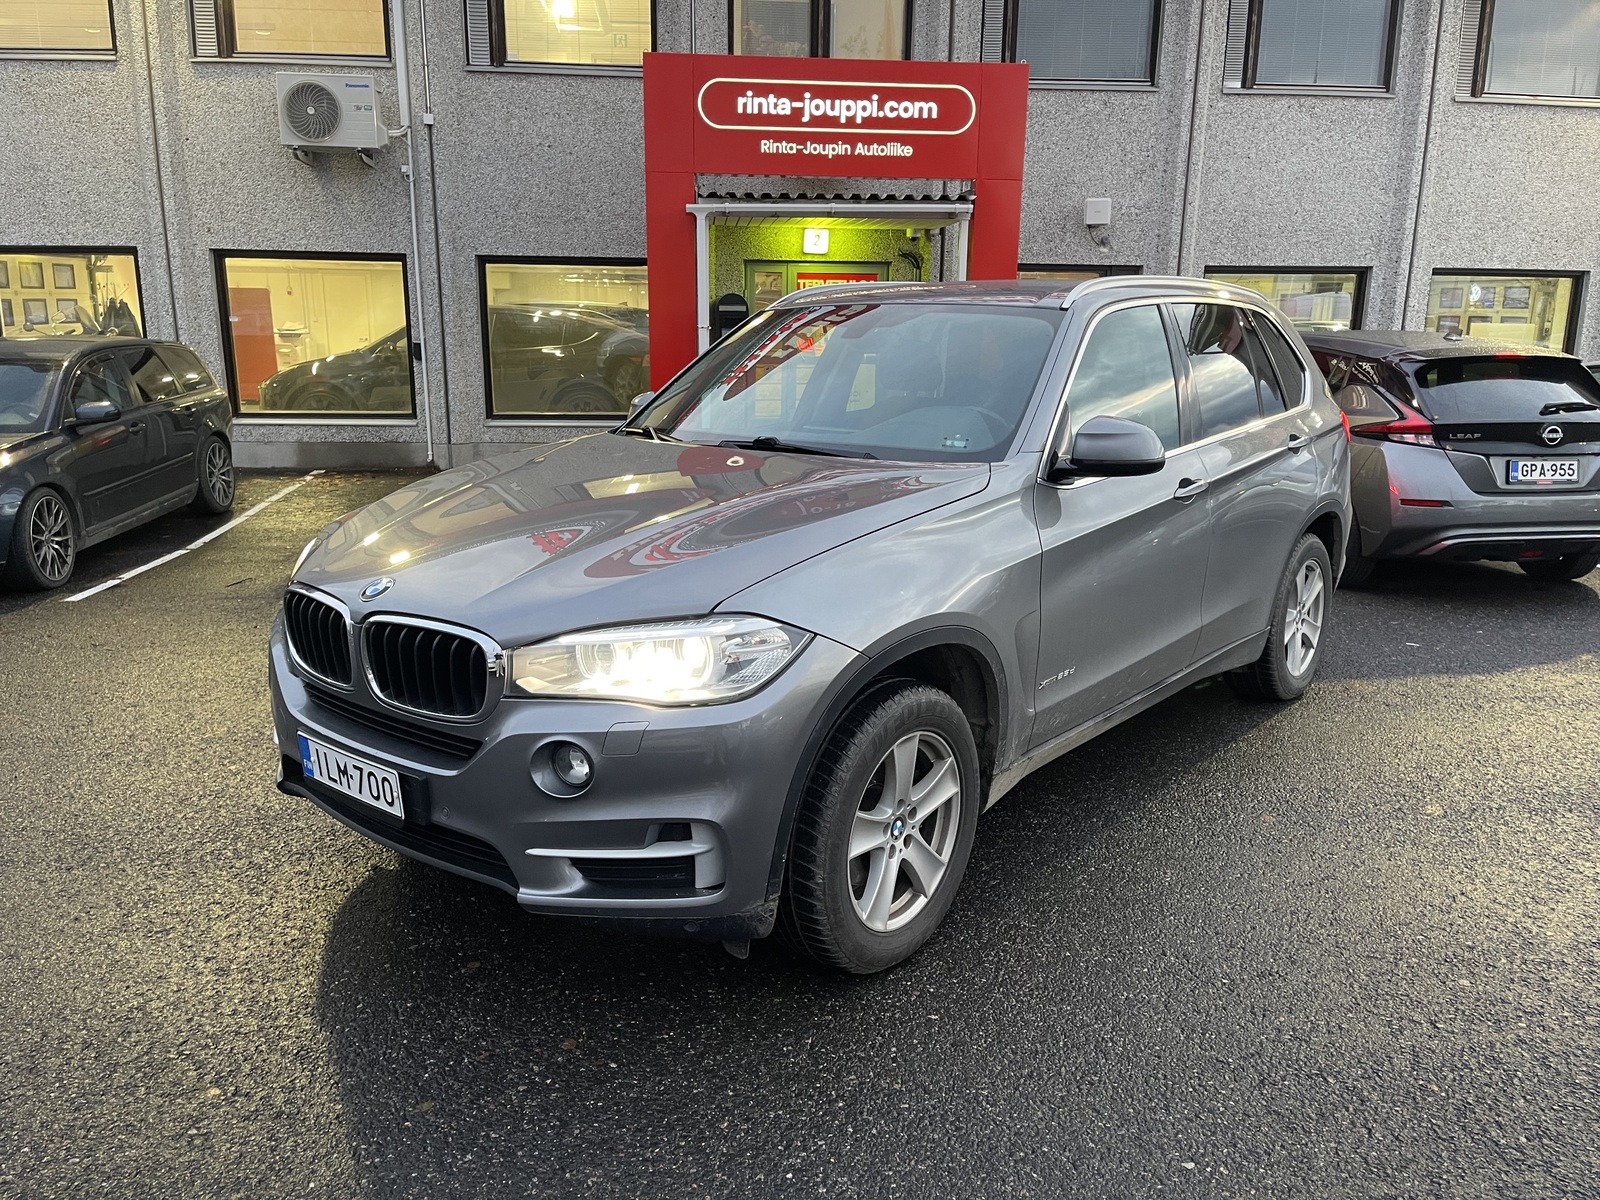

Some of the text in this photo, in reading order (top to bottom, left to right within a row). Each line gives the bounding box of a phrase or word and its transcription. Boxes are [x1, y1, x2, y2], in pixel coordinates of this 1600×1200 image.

[736, 90, 938, 124] rinta-jouppi.com
[760, 139, 913, 159] Rinta-Joupin Autoliike
[814, 234, 821, 247] 2
[315, 747, 395, 807] ILM-700
